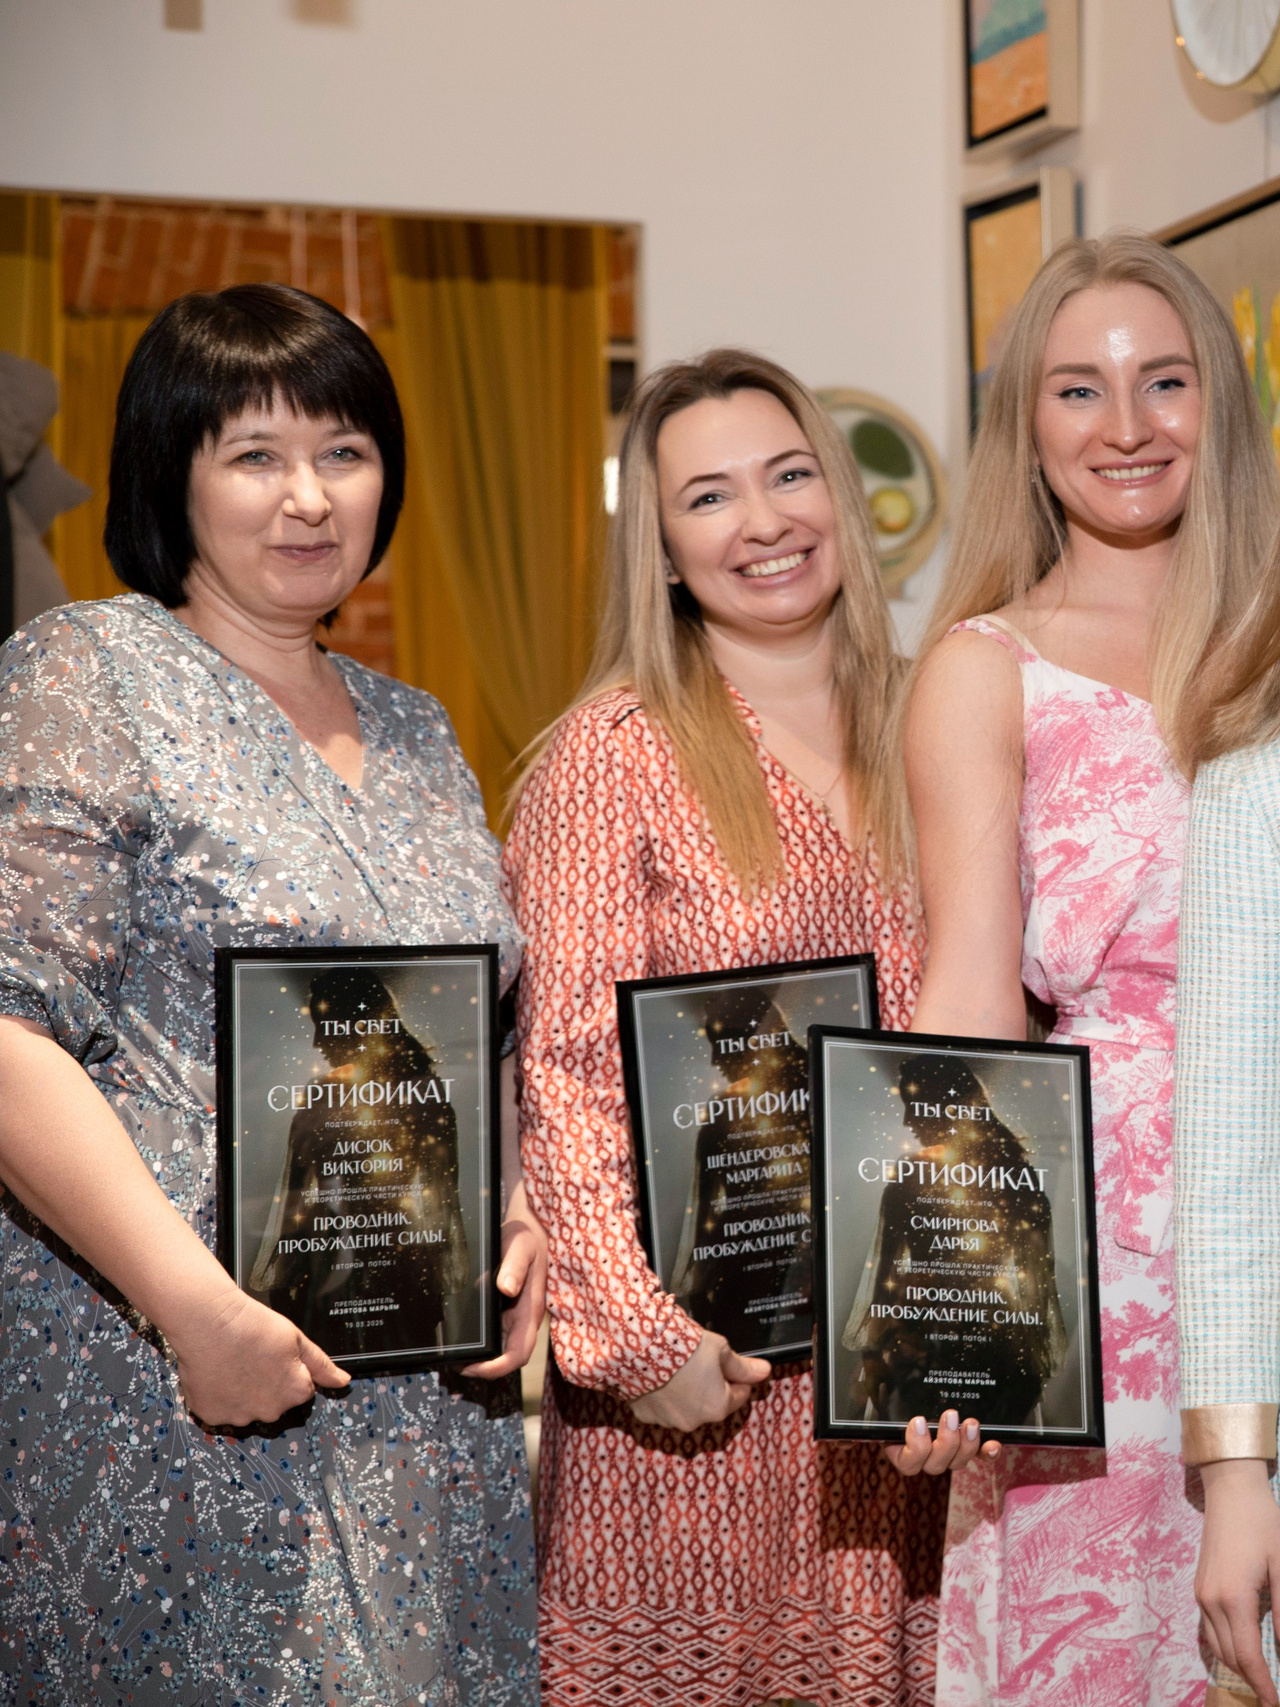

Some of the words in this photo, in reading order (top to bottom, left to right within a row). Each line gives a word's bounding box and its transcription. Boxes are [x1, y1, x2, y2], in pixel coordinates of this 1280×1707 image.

[321, 1019, 350, 1036] ТЫ
[354, 1018, 403, 1035] СВЕТ
[716, 1037, 744, 1054] ТЫ
[748, 1031, 791, 1049] СВЕТ
[268, 1079, 455, 1112] СЕРТИФИКАТ
[673, 1088, 810, 1130] СЕРТИФИК
[911, 1101, 941, 1118] ТЫ
[945, 1104, 993, 1121] СВЕТ
[333, 1139, 393, 1156] ДИСЮК
[707, 1143, 810, 1169] ШЕНДЕРОВСКА
[323, 1158, 403, 1176] ВИКТОРИЯ
[726, 1161, 802, 1184] МАРГАРИТА
[858, 1157, 1048, 1192] СЕРТИФИКАТ
[301, 1188, 337, 1197] УСПЕШНО
[369, 1184, 424, 1192] ПРАКТИЧЕСКУЮ
[312, 1194, 371, 1203] ТЕОРЕТИЧЕСКУЮ
[772, 1185, 810, 1195] ПРАКТИЧЕС
[314, 1212, 412, 1231] ПРОВОДНИК.
[911, 1215, 998, 1233] СМИРНОВА
[278, 1232, 394, 1254] ПРОБУЖДЕНИЕ
[398, 1229, 446, 1245] СИЛЫ.
[693, 1232, 797, 1261] ПРОБУЖДЕНИЕ
[930, 1235, 980, 1250] ДАРЬЯ
[336, 1262, 364, 1270] ВТОРОЙ
[776, 1258, 797, 1266] ПОТОК
[963, 1263, 1019, 1272] ПРАКТИЧЕСКУЮ
[904, 1267, 965, 1276] ТЕОРЕТИЧЕСКУЮ
[335, 1298, 394, 1308] ПРЕПОДАВАТЕЛЬ
[906, 1286, 1007, 1304] ПРОВОДНИК.
[329, 1306, 368, 1315] АЙЗЯТОВА
[369, 1304, 399, 1312] МАРЬЯМ
[870, 1304, 989, 1323] ПРОБУЖДЕНИЕ
[994, 1310, 1043, 1325] СИЛЫ.
[930, 1333, 958, 1341] ВТОРОЙ
[929, 1370, 990, 1378] ПРЕПОДАВАТЕЛЬ
[940, 1391, 980, 1399] 19.03.2025
